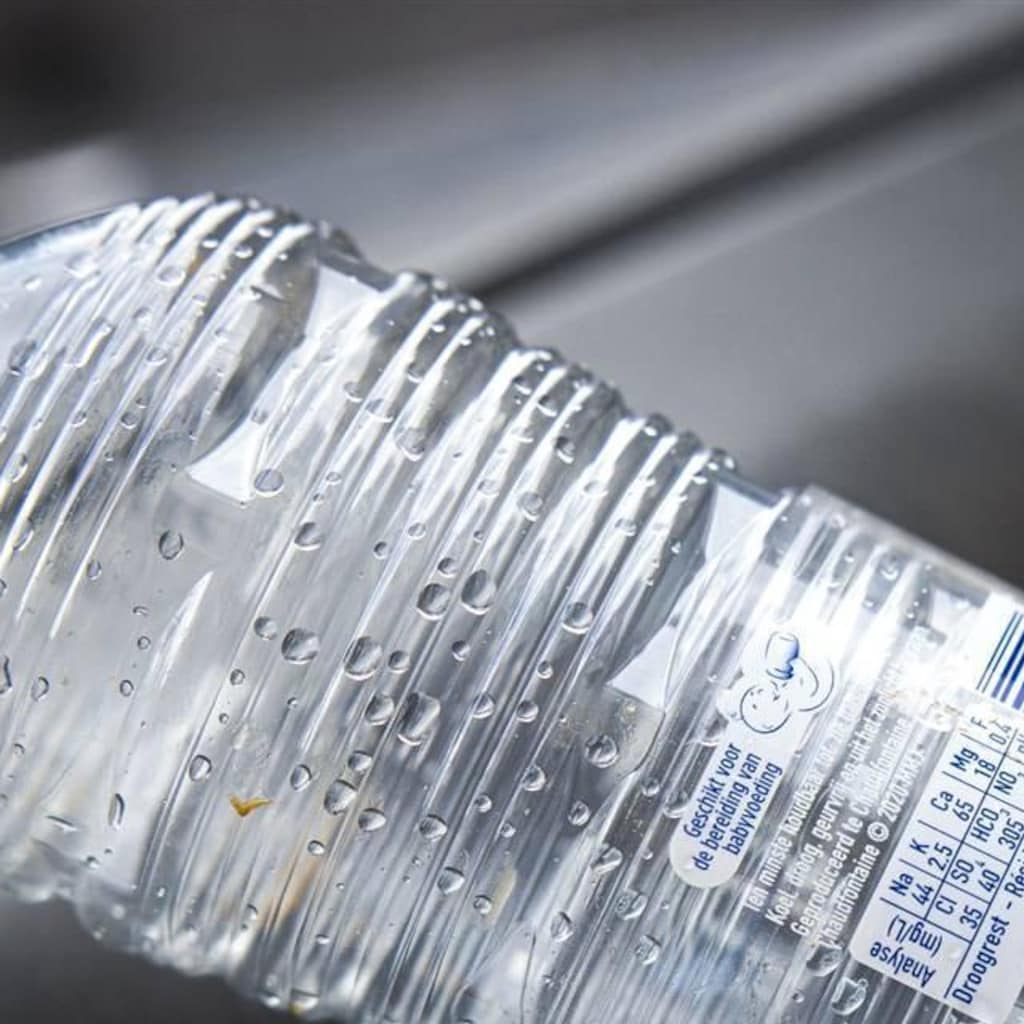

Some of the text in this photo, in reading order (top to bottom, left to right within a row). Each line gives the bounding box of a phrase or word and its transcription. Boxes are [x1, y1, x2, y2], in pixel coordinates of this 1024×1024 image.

[682, 742, 742, 840] Geschikt voor
[689, 751, 761, 872] de bereiding van
[721, 760, 784, 856] babyvoeding
[888, 870, 914, 897] Na
[909, 836, 929, 855] K
[929, 788, 954, 812] Ca
[949, 746, 979, 772] Mg
[910, 879, 934, 906] 44
[927, 841, 953, 872] 2.5
[951, 797, 975, 821] 65
[974, 757, 995, 780] 18
[755, 833, 793, 887] minste
[789, 830, 855, 939] Geproduceerd
[840, 812, 864, 835] te
[813, 840, 881, 950] Chaudfontaine
[875, 781, 909, 824] 2020
[934, 893, 957, 916] Cl
[959, 904, 982, 930] 35
[976, 867, 1000, 893] 40
[997, 816, 1024, 850] 305
[866, 935, 937, 988] Analyse
[888, 914, 941, 957] (mg/L)
[952, 913, 1010, 1005] Droogrest
